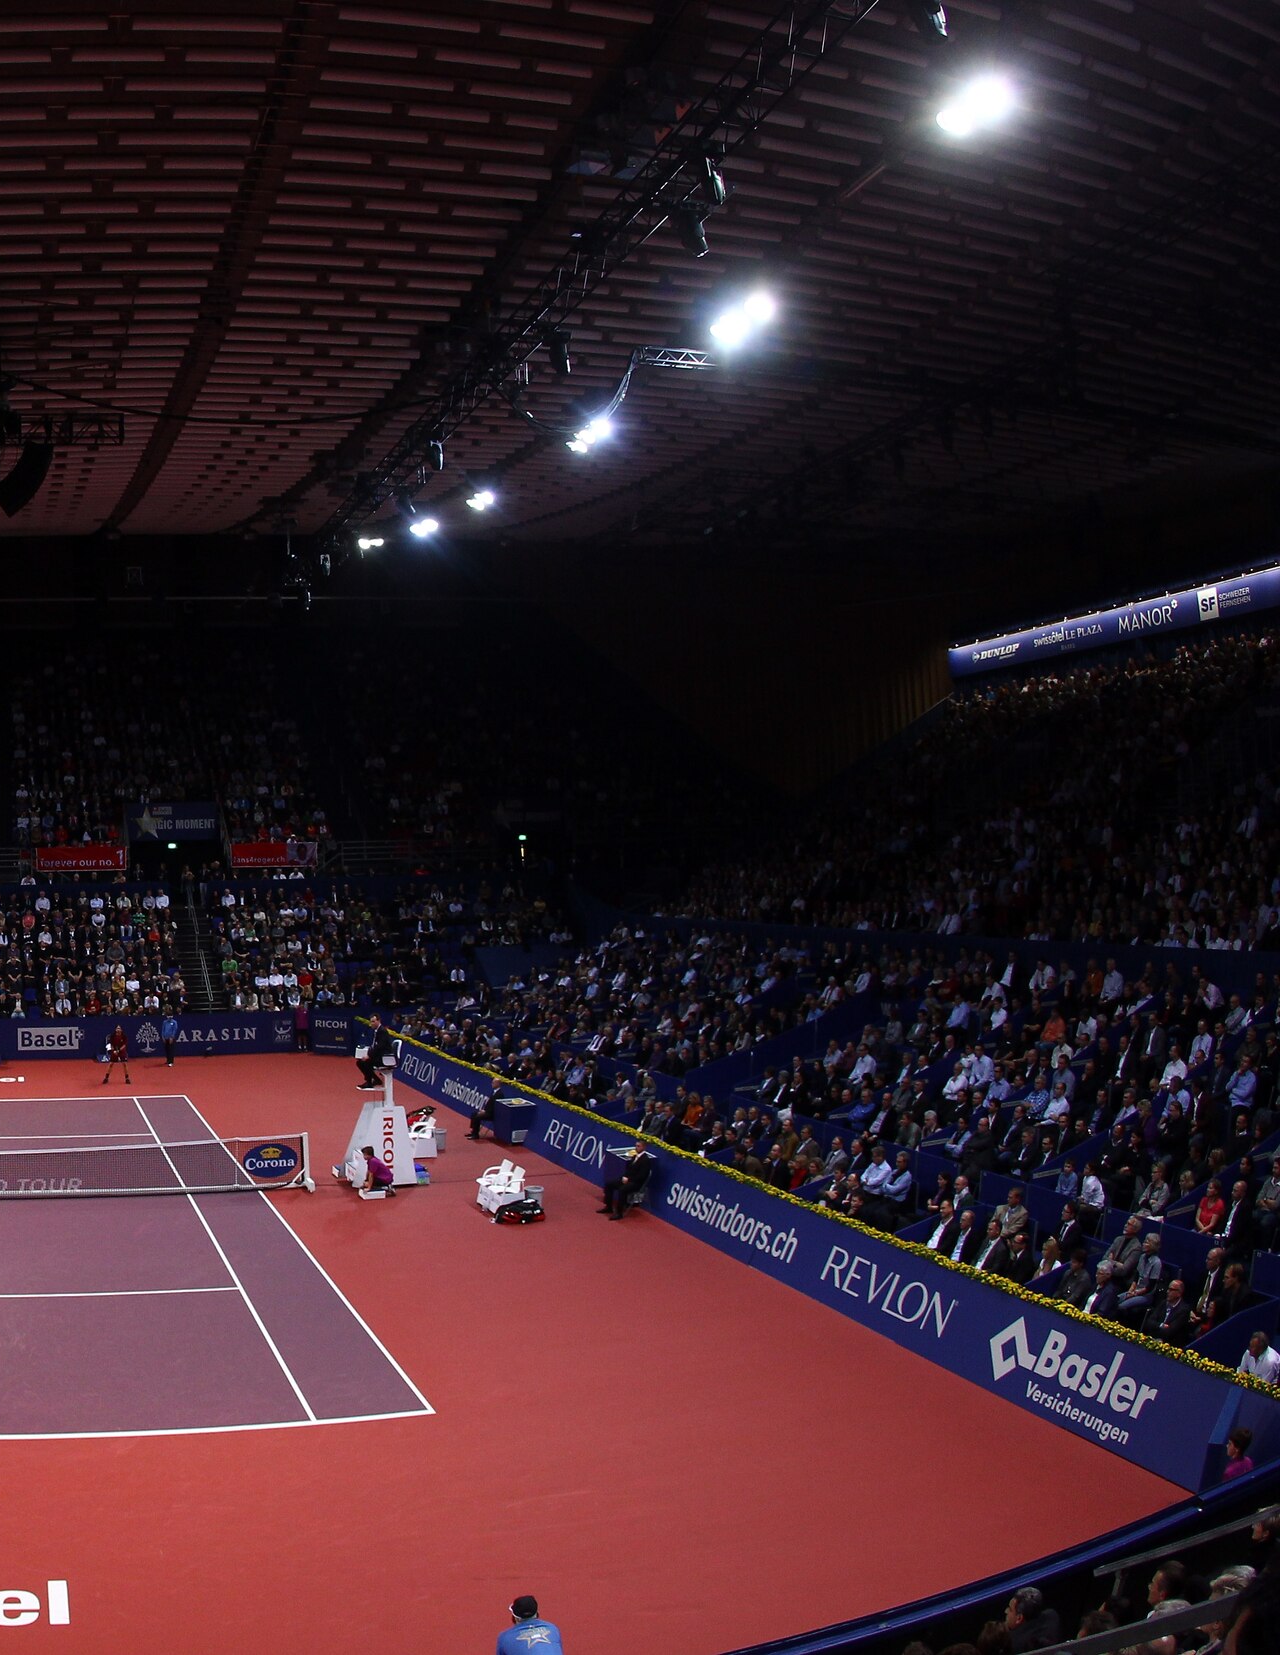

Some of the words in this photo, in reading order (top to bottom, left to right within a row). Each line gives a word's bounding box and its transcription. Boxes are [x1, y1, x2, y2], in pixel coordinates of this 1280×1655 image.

[1218, 587, 1250, 602] SCHWEIZER
[1219, 594, 1252, 609] FERNSEHEN
[1200, 596, 1216, 613] SF
[1118, 605, 1173, 634] MANOR
[980, 643, 1020, 660] DUNLOP
[175, 818, 216, 830] MOMENT
[79, 858, 97, 867] our
[315, 1019, 348, 1030] RICOH
[21, 1029, 74, 1047] Basel
[176, 1027, 257, 1043] ARASIN
[401, 1053, 440, 1086] REVLON
[382, 1117, 395, 1169] RICO
[543, 1118, 606, 1169] REVLON
[245, 1158, 295, 1171] Corona
[667, 1182, 798, 1264] swissindoors.ch
[820, 1244, 956, 1339] REVLON
[1033, 1328, 1158, 1420] Basler
[1026, 1380, 1129, 1445] Versicherungen
